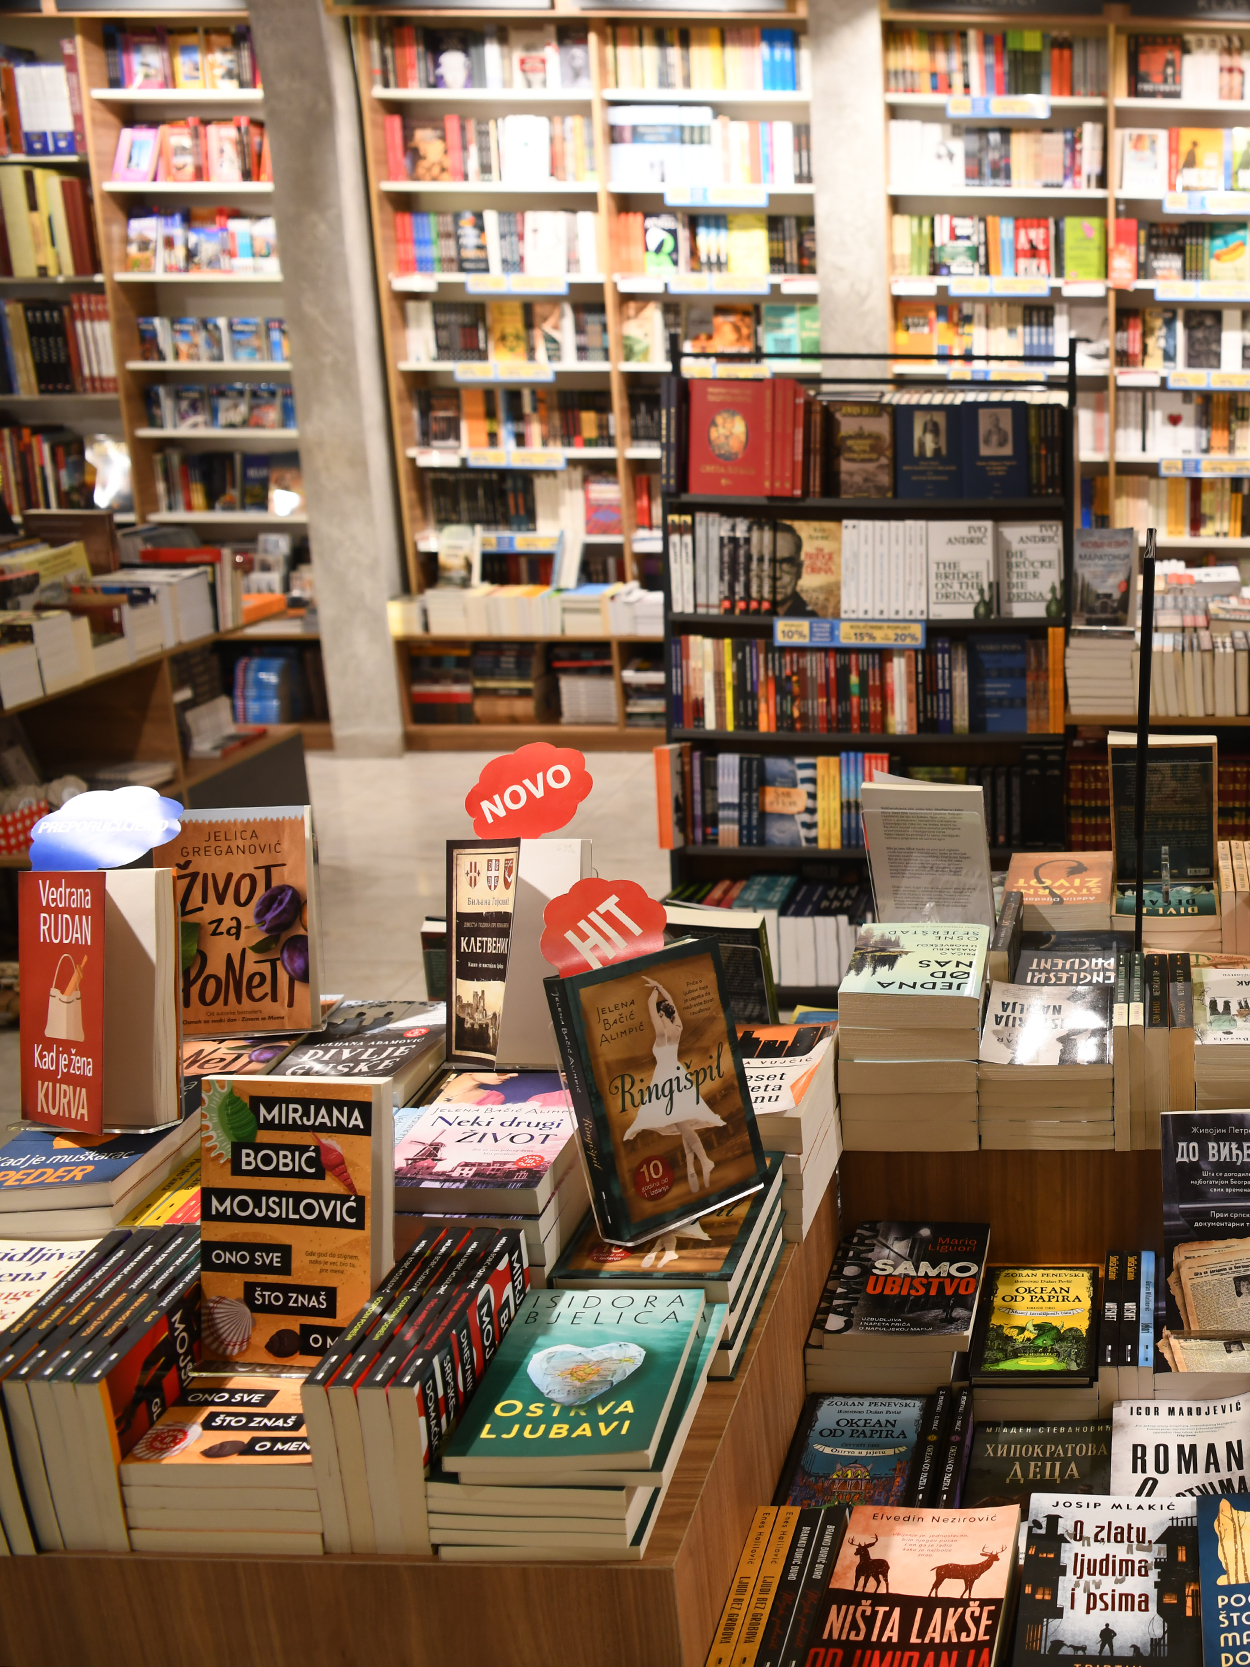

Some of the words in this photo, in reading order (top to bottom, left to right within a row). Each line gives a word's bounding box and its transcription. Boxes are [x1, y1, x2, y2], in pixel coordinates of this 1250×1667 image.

[479, 763, 572, 824] NOVO
[204, 830, 259, 842] JELICA
[181, 840, 282, 857] GREGANOVIĆ
[39, 880, 91, 907] Vedrana
[39, 913, 91, 945] RUDAN
[564, 893, 644, 970] HIT
[918, 959, 973, 968] NAS
[876, 980, 969, 991] JEDNA
[597, 999, 635, 1024] JELENA
[600, 1024, 644, 1047] ALIMPIĆ
[34, 1043, 56, 1072] Kad
[57, 1052, 70, 1079] je
[70, 1051, 93, 1077] žena
[298, 1045, 416, 1061] DIVLJE
[760, 1057, 812, 1065] VUJČIĆ
[286, 1058, 401, 1076] GUSKE
[609, 1042, 724, 1115] Ringišpil
[37, 1080, 88, 1121] KURVA
[259, 1102, 364, 1129] MIRJANA
[431, 1116, 495, 1127] Neki
[500, 1117, 564, 1130] drugi
[455, 1130, 557, 1144] ŽIVOT
[1191, 1127, 1226, 1135] Живојин
[241, 1146, 317, 1174] BOBIĆ
[1176, 1142, 1199, 1163] ДО
[0, 1165, 95, 1186] PEDER
[640, 1159, 663, 1183] 10
[211, 1194, 357, 1224] MOJSILOVIĆ
[928, 1244, 976, 1253] Liguori
[938, 1237, 977, 1245] Mario
[212, 1250, 249, 1265] ONO
[254, 1252, 281, 1267] SVE
[872, 1259, 978, 1277] SAMO
[866, 1275, 977, 1296] UBISTVO
[254, 1289, 286, 1306] ŠTO
[290, 1290, 327, 1309] ZNAŠ
[532, 1295, 685, 1309] ISIDORA
[524, 1310, 679, 1325] BJELICA
[188, 1392, 227, 1404] ONO
[232, 1392, 264, 1404] SVE
[827, 1400, 864, 1408] ZORAN
[868, 1401, 916, 1409] PENEVSKI
[494, 1399, 635, 1417] OSTRVA
[1130, 1405, 1160, 1416] IGOR
[1168, 1400, 1242, 1416] MAROJEVIĆ
[212, 1413, 248, 1427] ŠTO
[253, 1414, 297, 1427] ZNAŠ
[836, 1417, 898, 1428] OKEAN
[480, 1421, 630, 1439] LJUBAVI
[819, 1428, 845, 1438] OD
[848, 1429, 907, 1439] PAPIRA
[986, 1426, 1033, 1434] МЛАДЕН
[1038, 1425, 1112, 1434] СТЕВАНОВИЋ
[984, 1443, 1108, 1458] ХИПОКРАТОВА
[1131, 1439, 1245, 1475] ROMAN
[1005, 1460, 1081, 1484] ДЕЦА
[1051, 1500, 1101, 1510] JOSIP
[1110, 1501, 1176, 1511] MLAKIĆ
[872, 1512, 924, 1524] Elvedin
[931, 1513, 997, 1524] Nezirović
[1073, 1519, 1085, 1542] O
[1094, 1524, 1152, 1545] zlatu,
[1072, 1553, 1150, 1579] ljudima
[735, 1576, 751, 1595] LJUDI
[730, 1598, 744, 1611] BEZ
[1070, 1587, 1076, 1611] i
[1085, 1589, 1150, 1615] psima
[719, 1614, 739, 1644] GROBOVA
[822, 1600, 899, 1643] NIŠTA
[909, 1601, 996, 1645] LAKŠE
